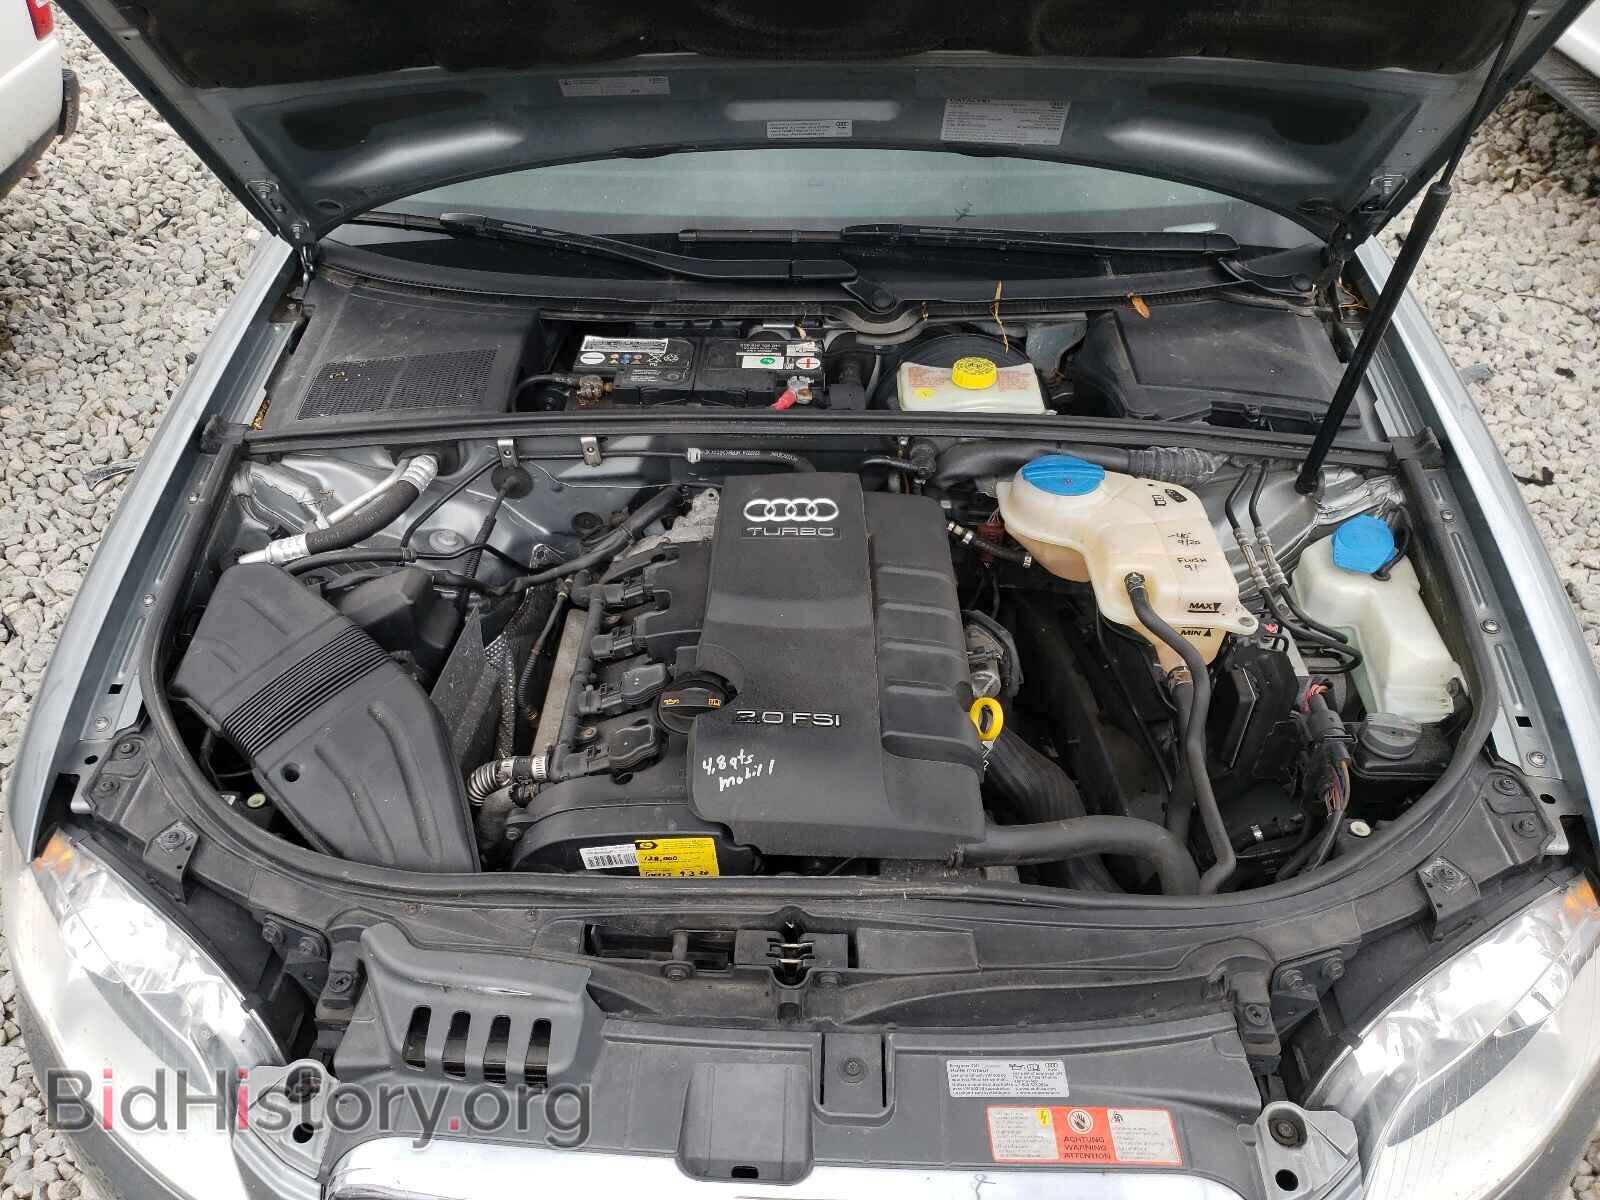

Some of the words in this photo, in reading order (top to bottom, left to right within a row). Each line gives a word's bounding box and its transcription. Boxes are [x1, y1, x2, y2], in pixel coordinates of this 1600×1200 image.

[746, 527, 835, 536] TURBO
[736, 710, 784, 724] 2.0
[792, 712, 840, 726] FSI
[1064, 1152, 1111, 1160] ATTENTION
